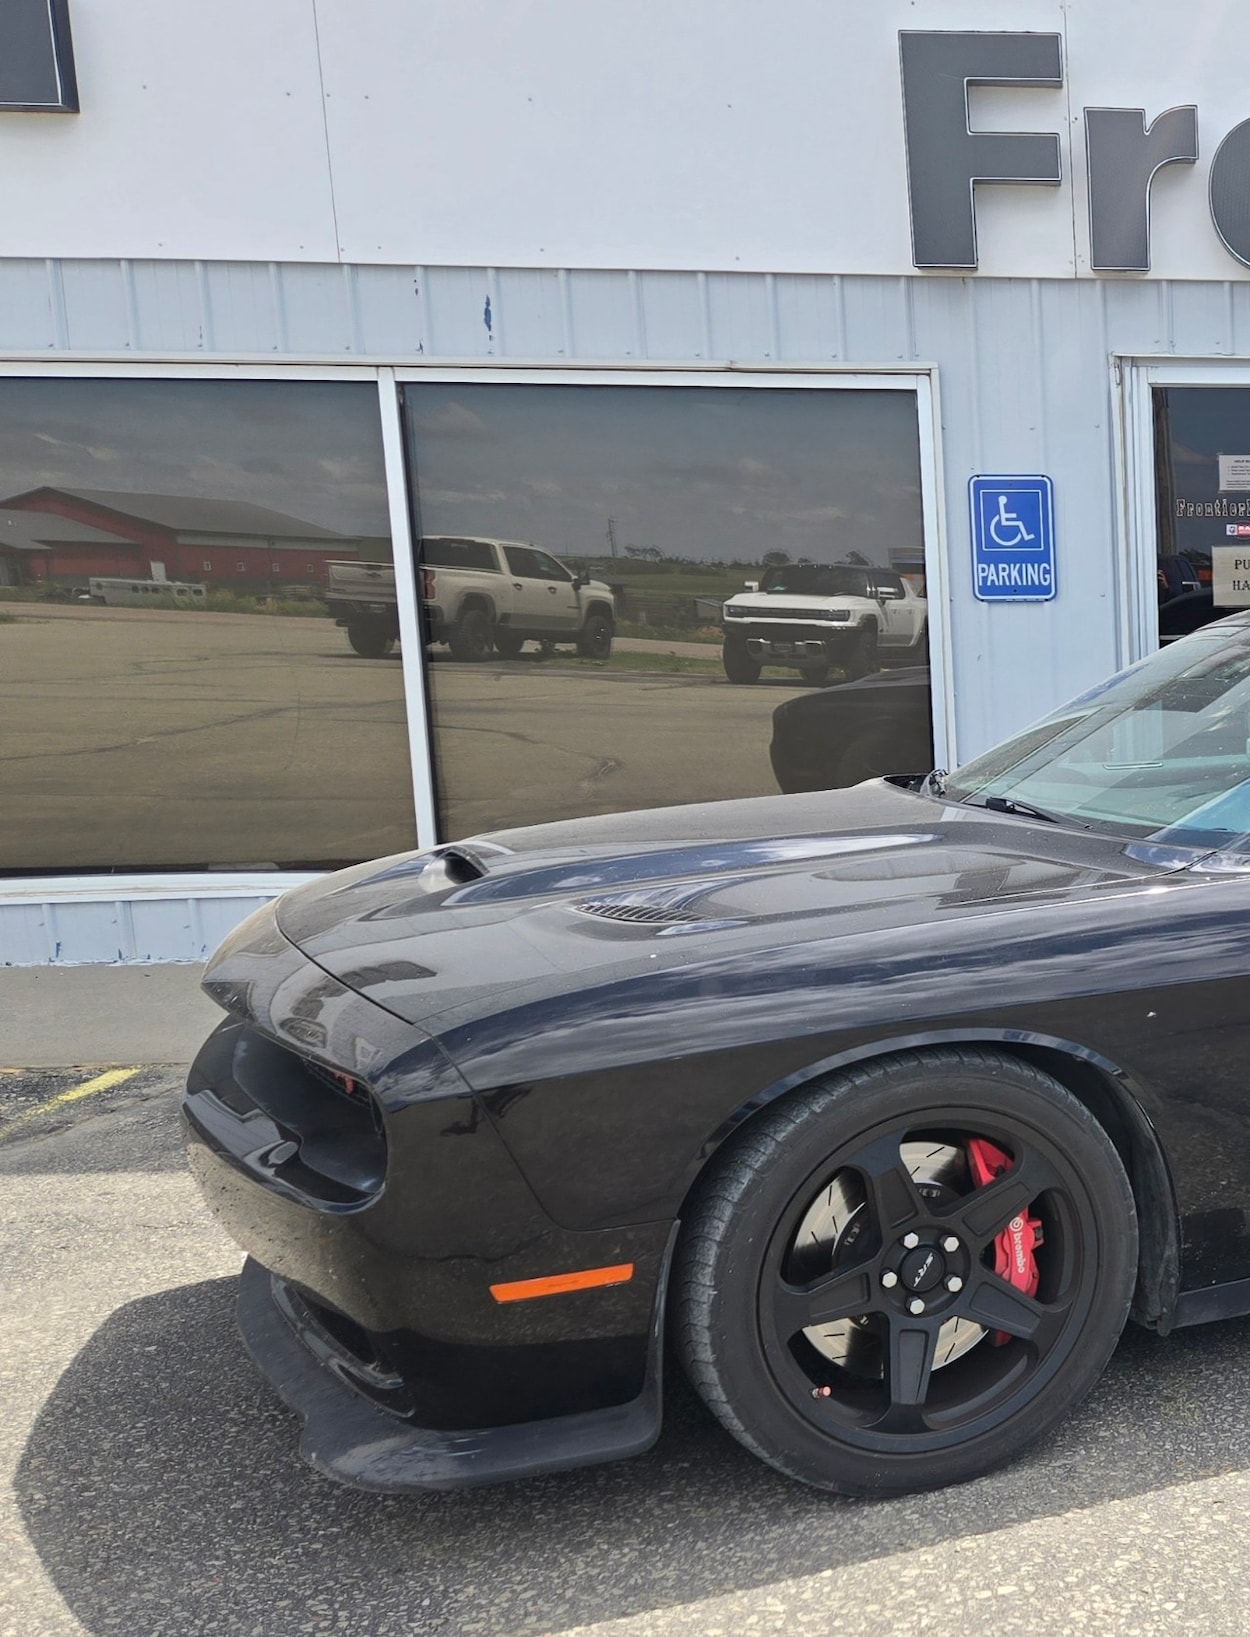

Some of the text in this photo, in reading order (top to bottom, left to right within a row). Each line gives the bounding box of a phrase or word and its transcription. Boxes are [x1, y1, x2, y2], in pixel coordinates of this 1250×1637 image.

[978, 563, 1051, 586] PARKING
[913, 1252, 934, 1287] SRT
[1013, 1231, 1025, 1274] brembo
